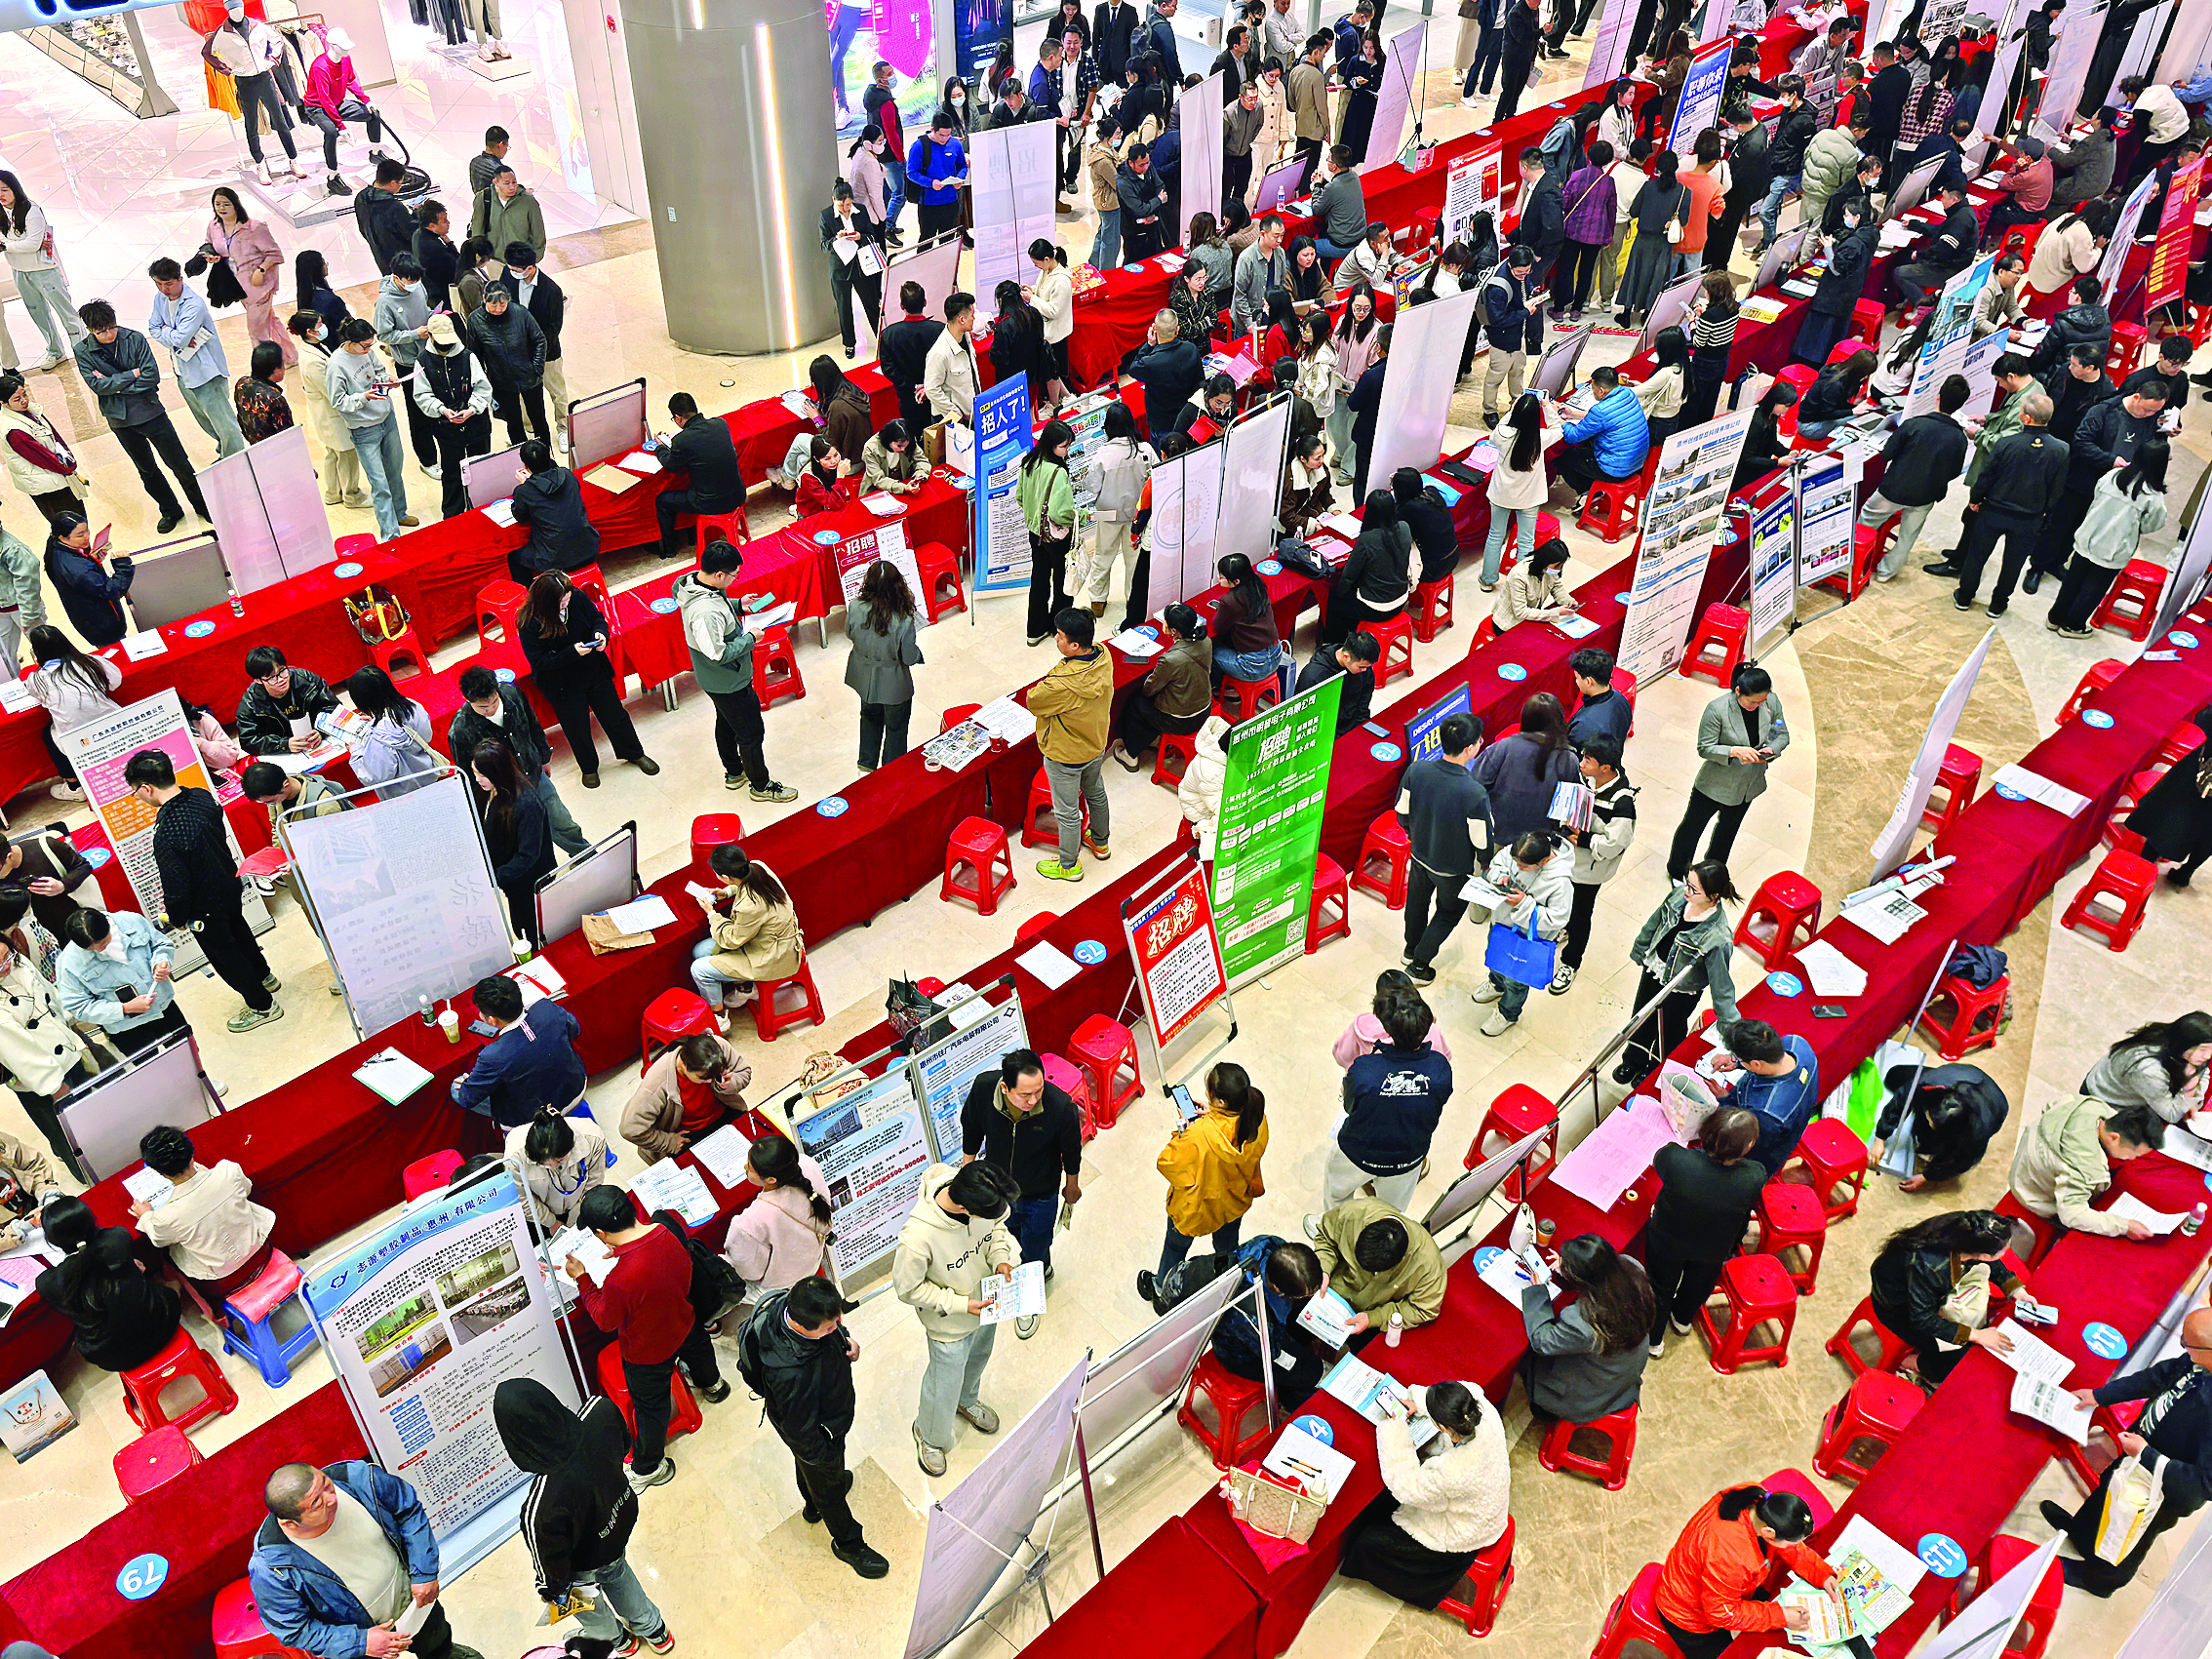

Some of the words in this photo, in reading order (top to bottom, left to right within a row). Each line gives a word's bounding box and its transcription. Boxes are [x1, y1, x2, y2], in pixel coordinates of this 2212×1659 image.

[846, 533, 876, 556] 招聘
[337, 564, 361, 578] 05
[1261, 562, 1280, 574] 48
[188, 621, 213, 637] 04
[2173, 632, 2195, 648] 91
[1500, 666, 1522, 680] 72
[1413, 717, 1435, 737] DESAY
[2087, 711, 2109, 727] 90
[1375, 745, 1398, 760] 73
[822, 798, 845, 815] 45
[1148, 894, 1198, 958] 招聘
[1077, 944, 1103, 964] 75
[1772, 973, 1796, 994] 87
[2087, 1324, 2121, 1358] 114
[1922, 1537, 1961, 1574] 115
[123, 1560, 163, 1594] 79
